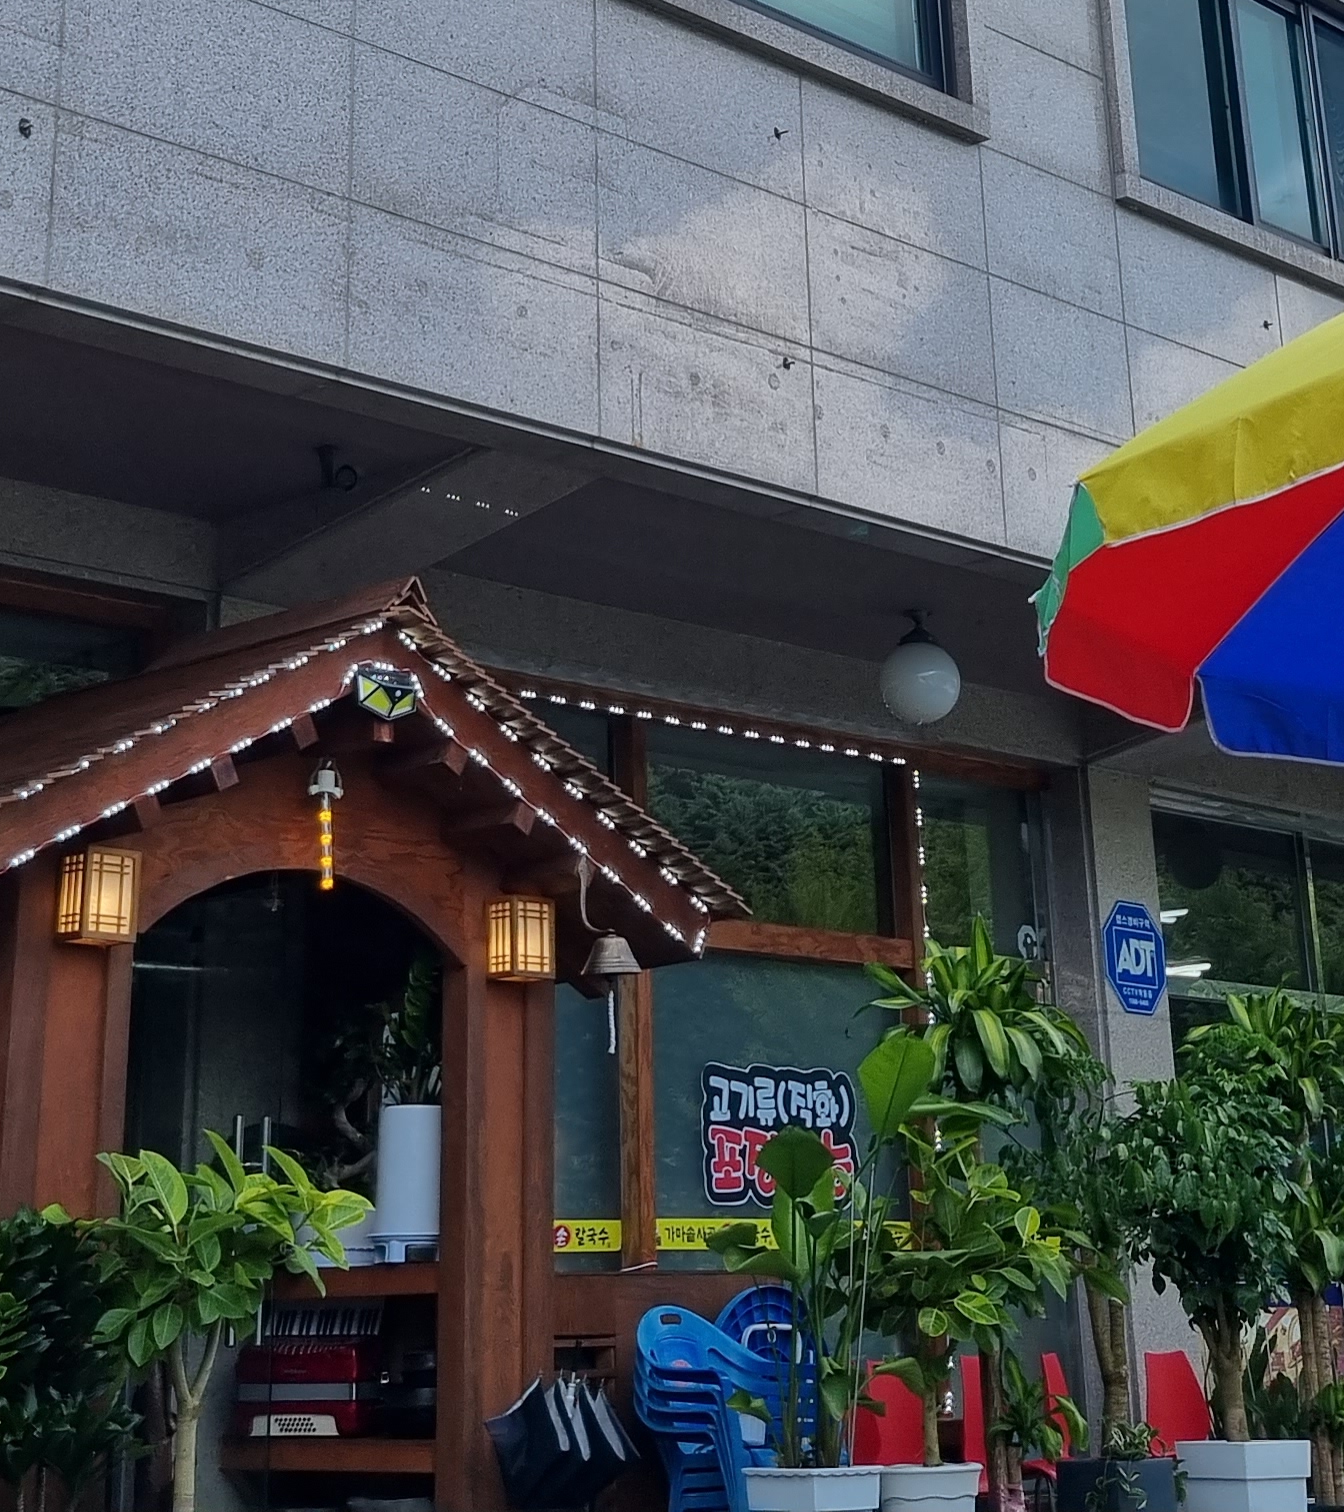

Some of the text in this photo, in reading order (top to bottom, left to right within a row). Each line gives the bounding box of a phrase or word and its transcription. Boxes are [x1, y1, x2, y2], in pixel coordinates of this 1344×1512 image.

[1116, 938, 1155, 977] ADT
[709, 1075, 850, 1128] 고기류(직화)
[574, 1230, 610, 1247] 칼국수
